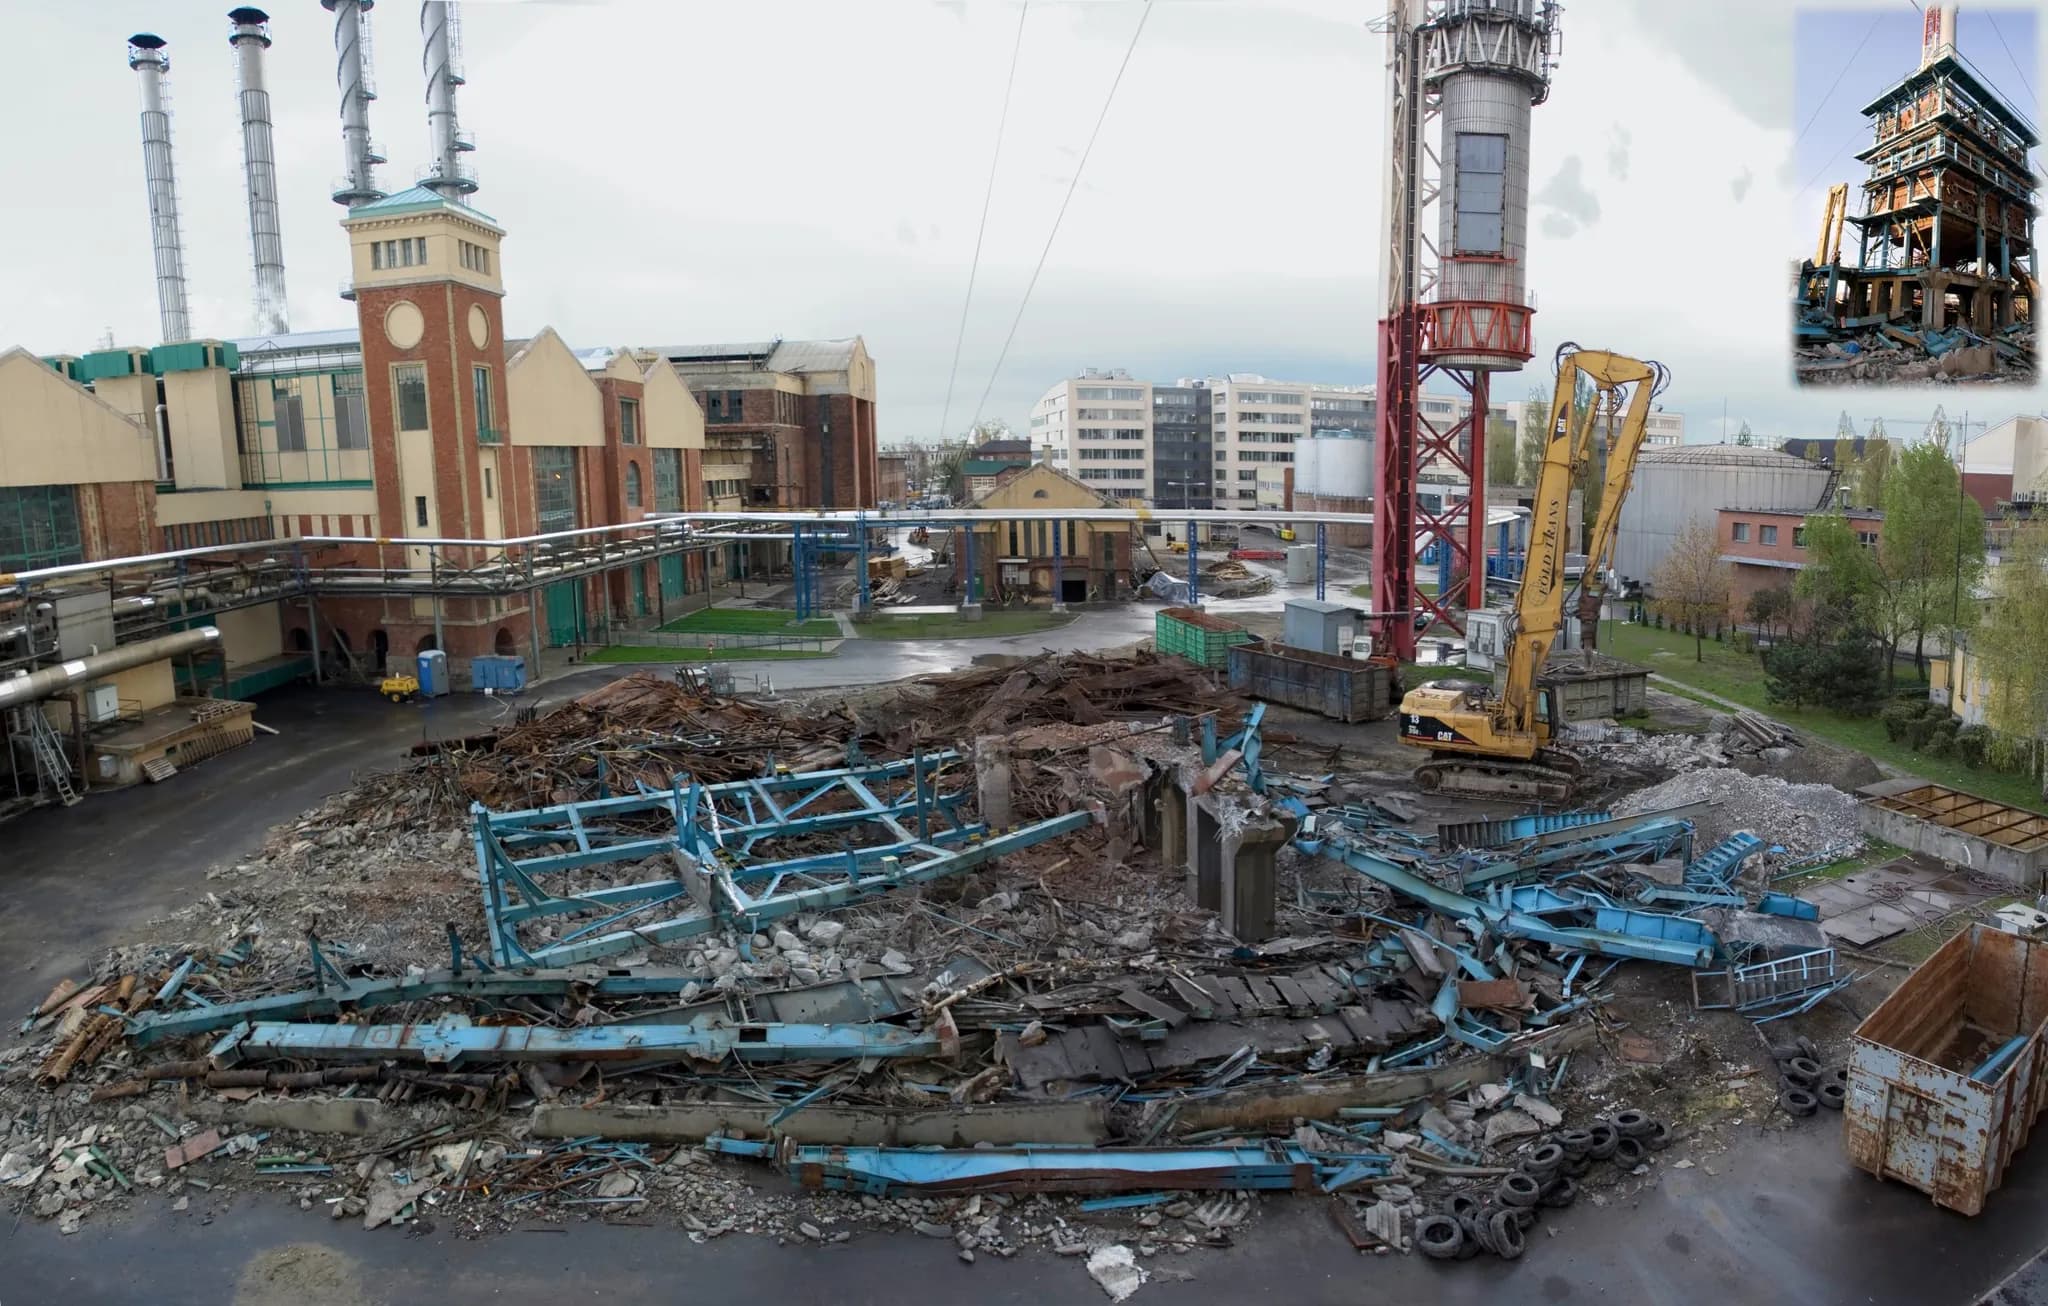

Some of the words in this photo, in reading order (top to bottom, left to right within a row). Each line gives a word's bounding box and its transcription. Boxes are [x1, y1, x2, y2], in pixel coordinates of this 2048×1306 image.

[1557, 418, 1567, 433] CAT
[1410, 714, 1420, 725] 13
[1437, 731, 1453, 742] CAT
